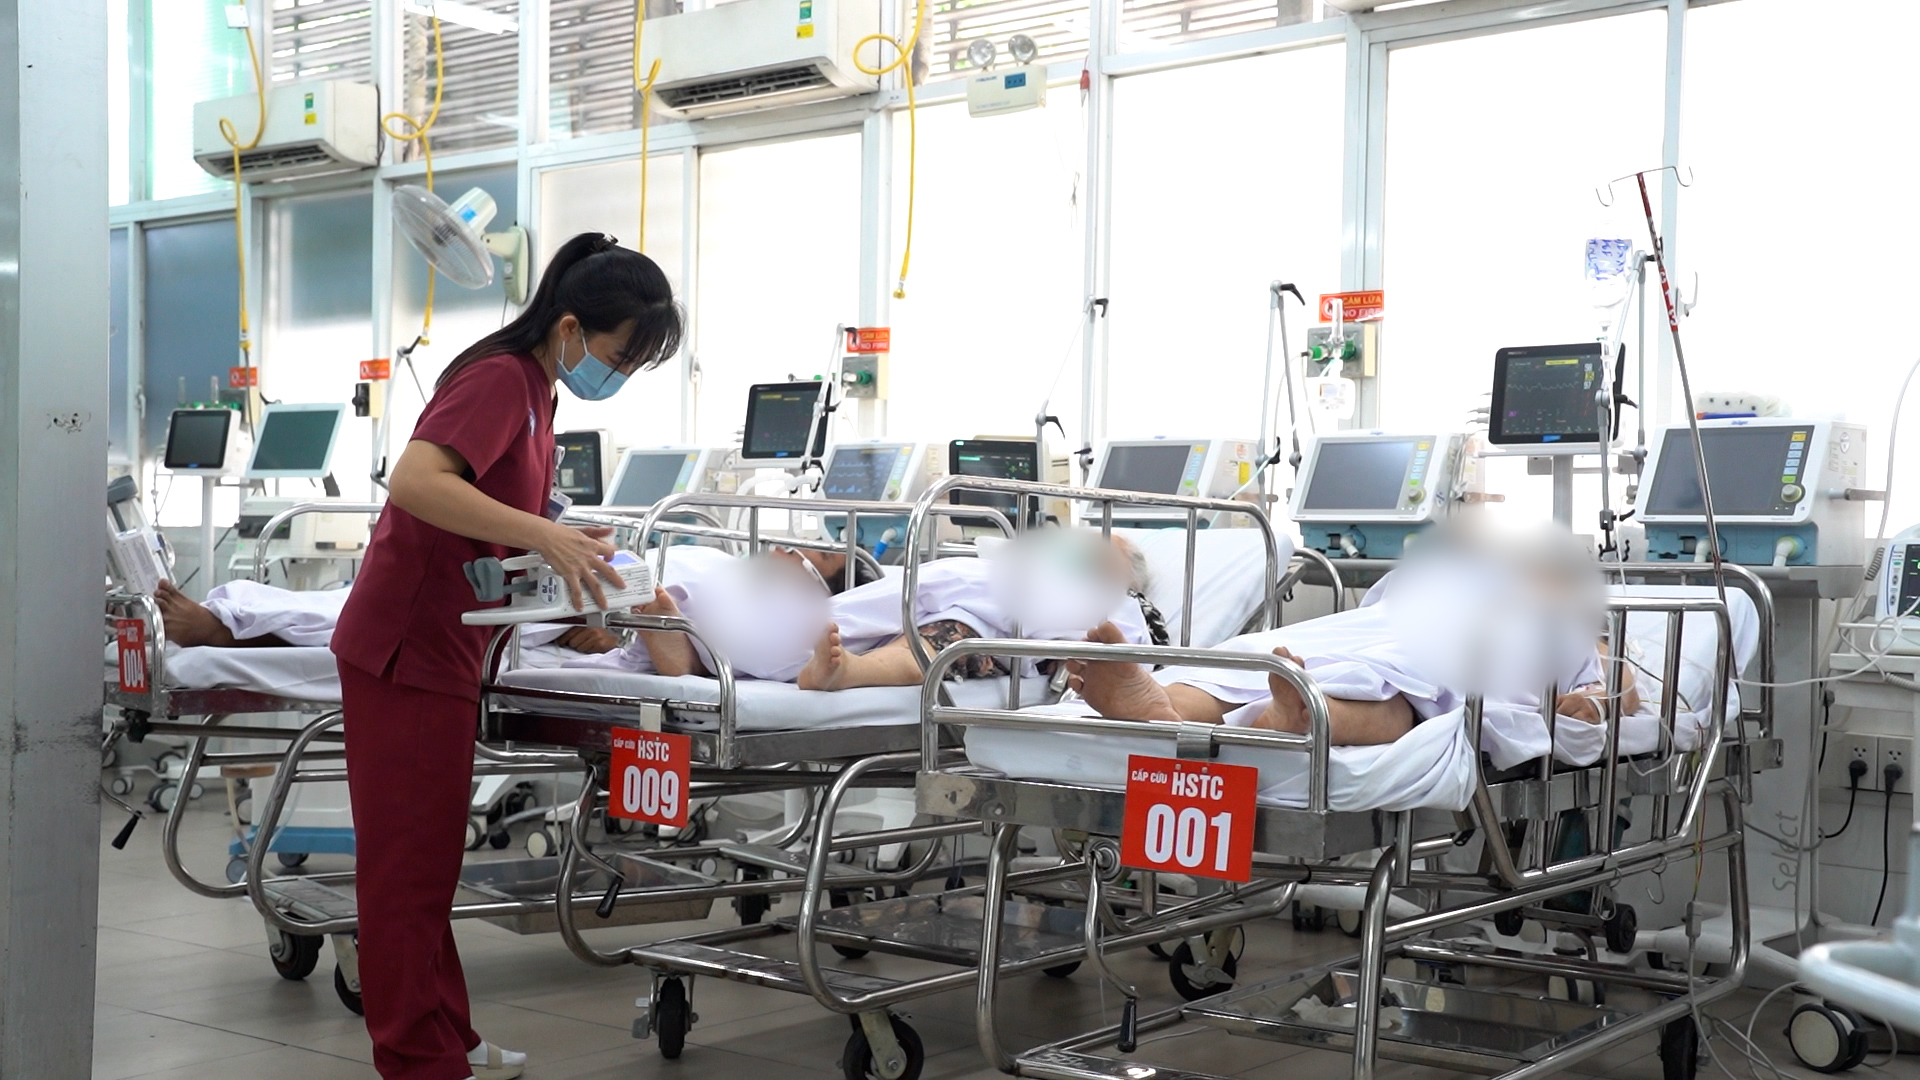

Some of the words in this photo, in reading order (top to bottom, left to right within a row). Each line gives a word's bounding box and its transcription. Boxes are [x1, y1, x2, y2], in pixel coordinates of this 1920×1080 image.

[123, 648, 144, 688] 004
[637, 739, 670, 762] HSTC
[623, 765, 680, 819] 009
[1171, 771, 1224, 800] HSTC
[1144, 803, 1232, 872] 001
[1771, 810, 1799, 891] Select
